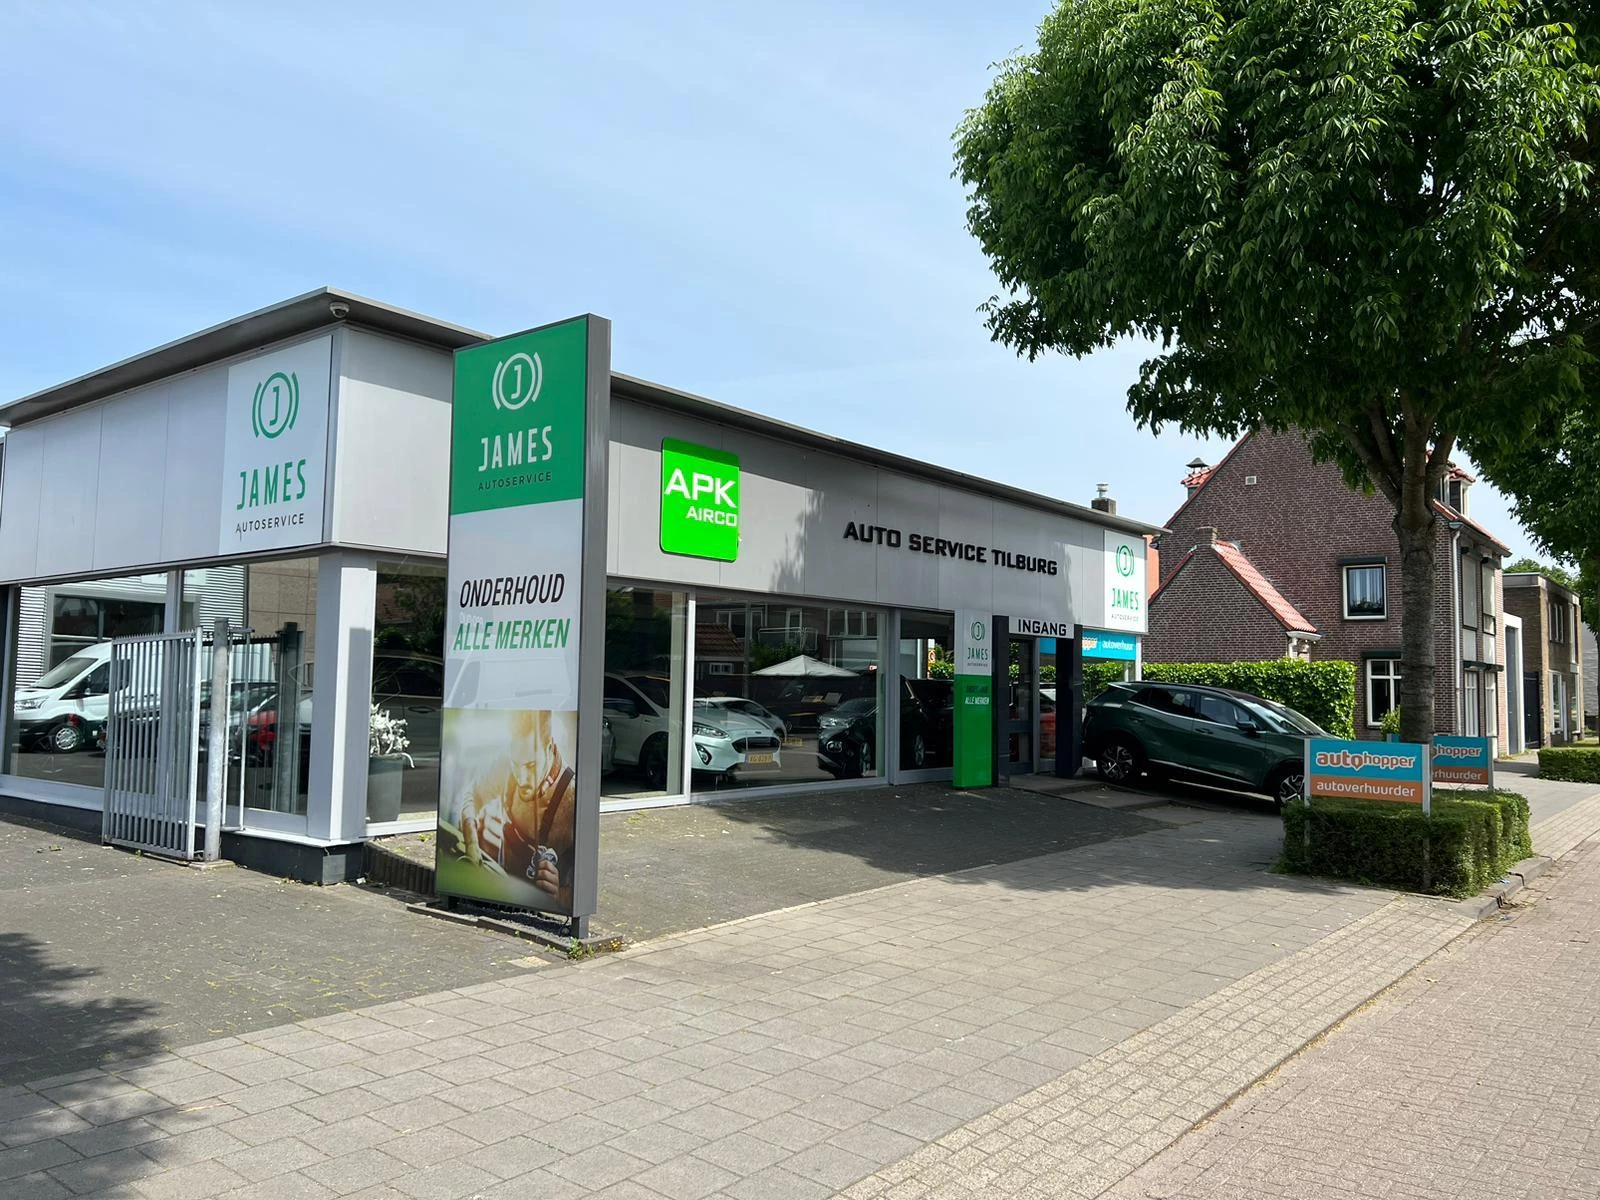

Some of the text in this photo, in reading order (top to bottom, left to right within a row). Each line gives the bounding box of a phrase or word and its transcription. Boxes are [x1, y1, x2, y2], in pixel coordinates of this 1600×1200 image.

[478, 425, 553, 472] JAMES
[236, 458, 307, 510] JAMES
[478, 471, 552, 491] AUTOSERVICE
[664, 467, 737, 508] APK
[235, 513, 305, 534] AUTOSERVICE
[685, 505, 738, 527] AIRCO
[843, 521, 1058, 576] AUTO SERVICE TILBURG
[459, 573, 565, 608] ONDERHOUD
[1111, 587, 1139, 611] JAMES
[453, 618, 571, 651] ALLE MERKEN
[1017, 618, 1067, 637] INGANG
[967, 647, 988, 661] JAMES
[1316, 750, 1415, 771] autohopper
[1316, 781, 1416, 797] autoverhuurder
